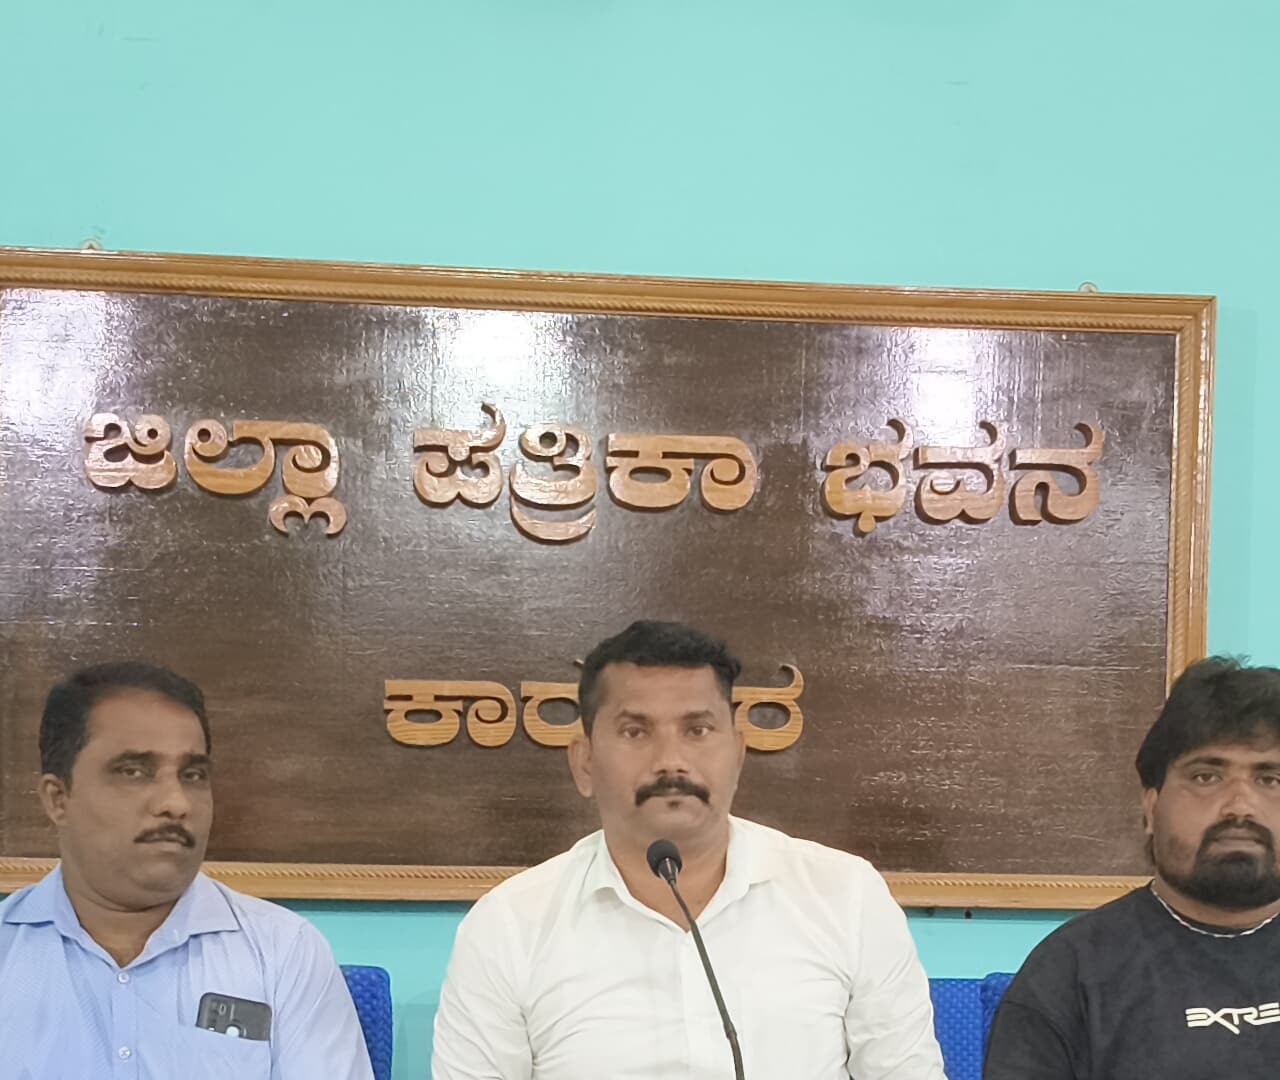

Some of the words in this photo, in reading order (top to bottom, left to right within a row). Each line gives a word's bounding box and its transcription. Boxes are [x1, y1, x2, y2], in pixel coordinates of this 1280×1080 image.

[84, 412, 347, 535] ಜಿಲ್ಲಾ
[412, 402, 758, 541] ಪತ್ರಿಕಾ
[822, 418, 1104, 535] ಭವನ
[384, 659, 805, 751] ಕಾರರ
